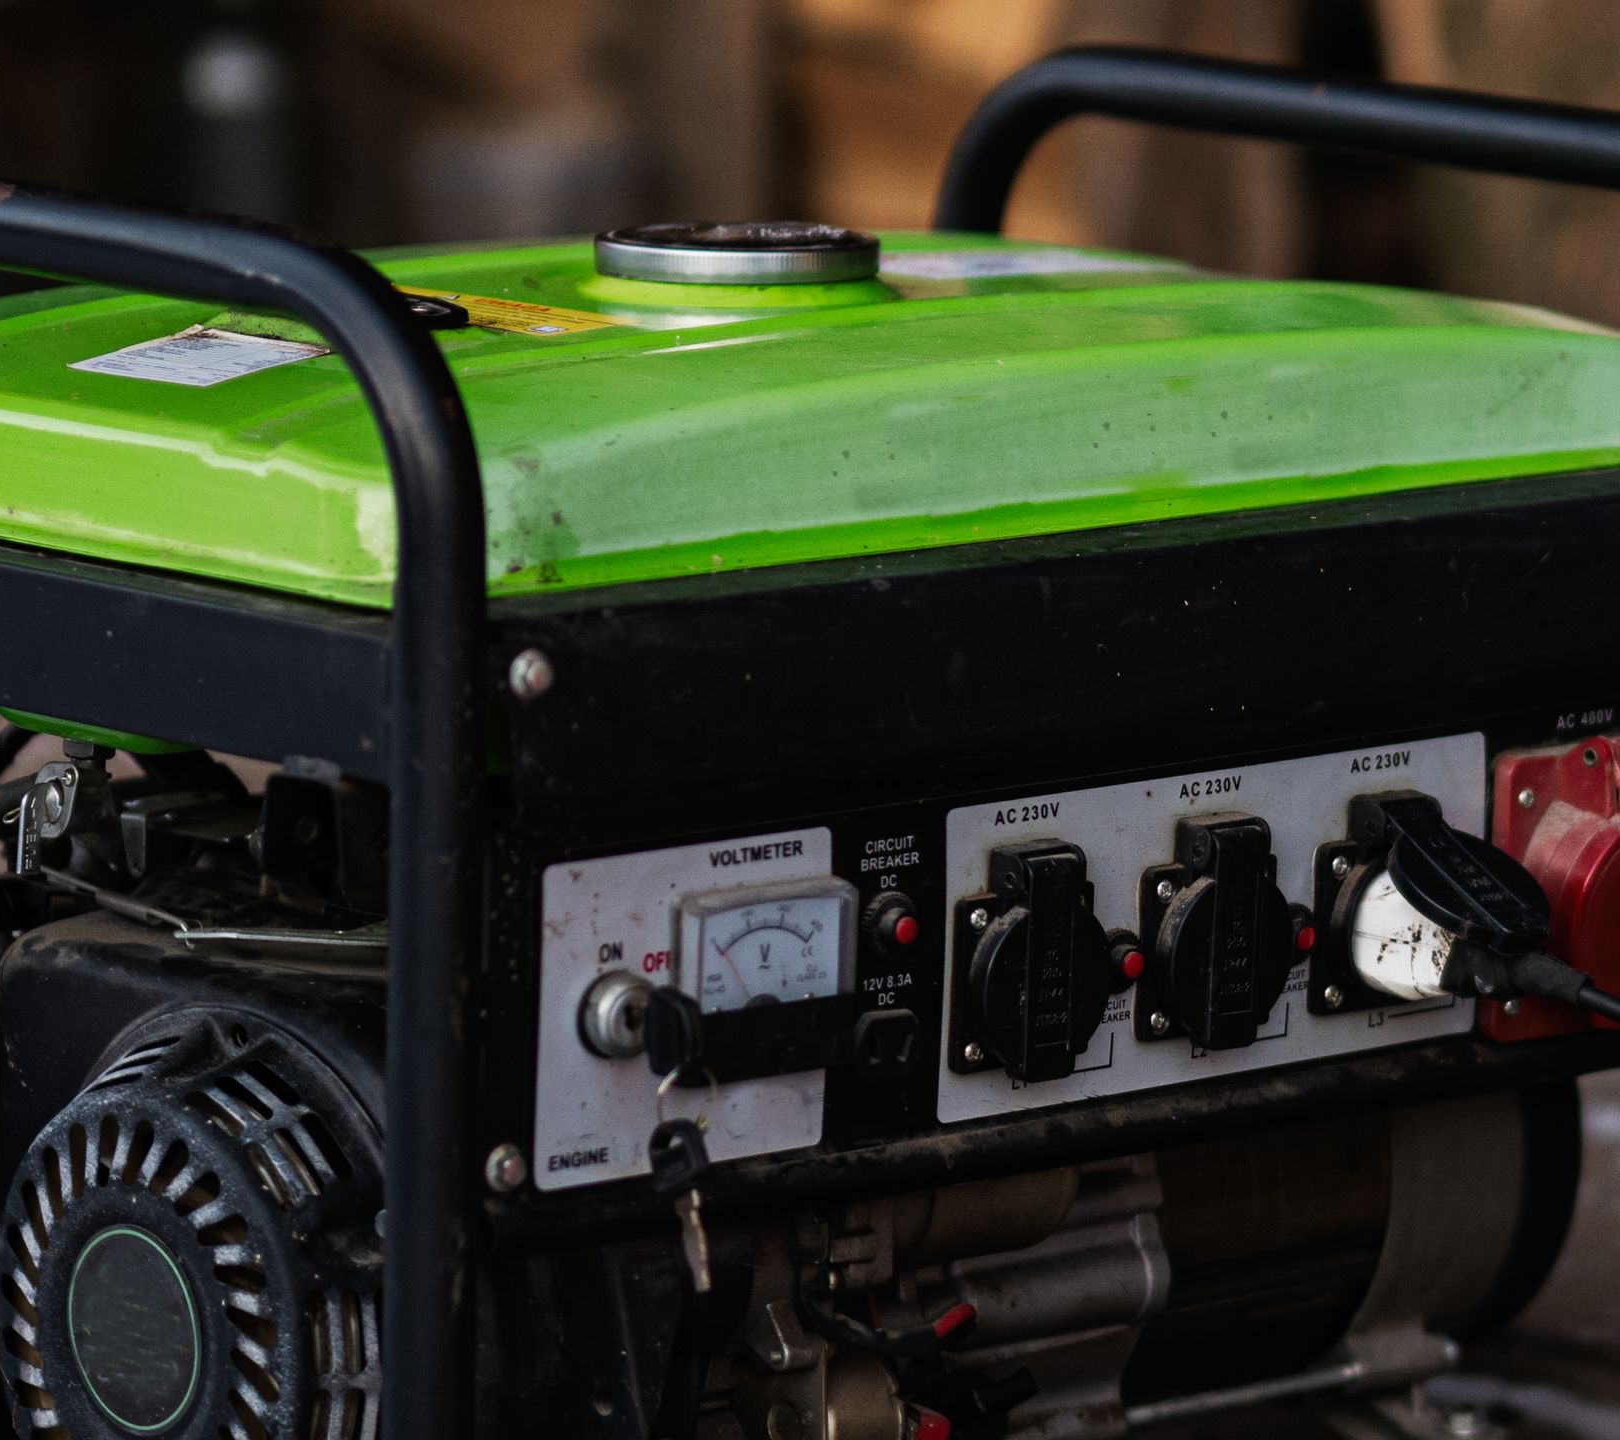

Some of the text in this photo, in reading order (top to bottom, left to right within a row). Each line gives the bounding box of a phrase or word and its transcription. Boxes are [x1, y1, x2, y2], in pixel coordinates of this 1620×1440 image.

[1556, 708, 1613, 730] AC 400V
[1350, 751, 1411, 773] AC 230V
[1179, 776, 1242, 799] AC 230V
[994, 802, 1060, 826] AC 230V
[710, 840, 803, 867] VOLTMETER
[865, 835, 914, 854] CIRCUIT
[860, 852, 920, 872] BREAKER
[880, 874, 898, 888] DC
[599, 942, 623, 963] ON
[760, 943, 771, 963] V
[862, 973, 912, 991] 12V 8.3A
[878, 992, 895, 1006] DC
[1107, 999, 1126, 1011] CUIT
[1101, 1011, 1131, 1024] EAKER
[1368, 1011, 1384, 1028] L3
[548, 1147, 609, 1172] ENGINE
